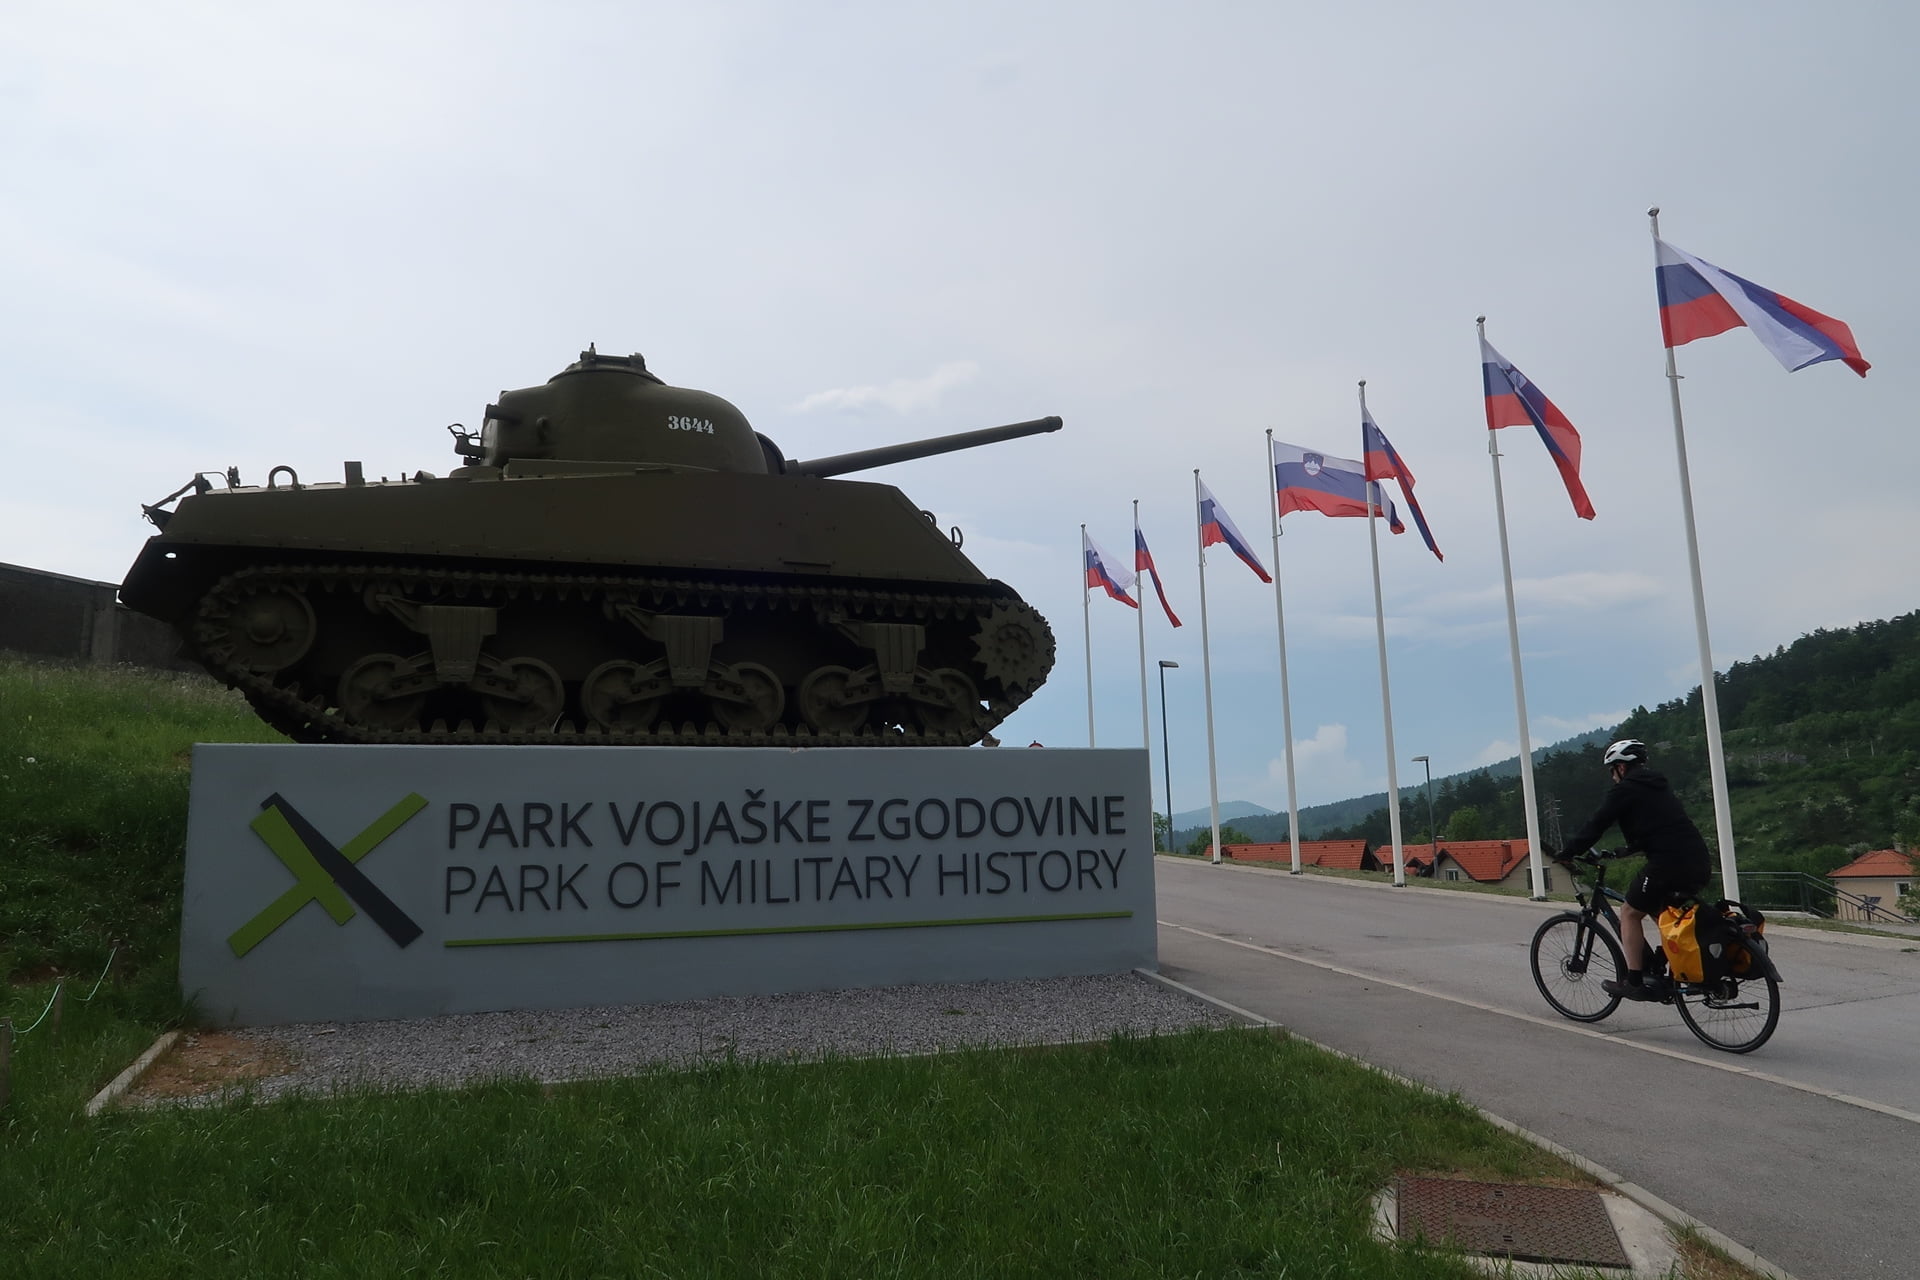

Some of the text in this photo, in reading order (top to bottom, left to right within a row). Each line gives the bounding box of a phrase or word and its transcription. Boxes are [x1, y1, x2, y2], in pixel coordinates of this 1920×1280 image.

[668, 415, 714, 434] 3644
[450, 788, 1126, 856] PARK VOJAŠKE ZGODOVINE
[445, 848, 1127, 915] PARK OF MILITARY HISTORY
